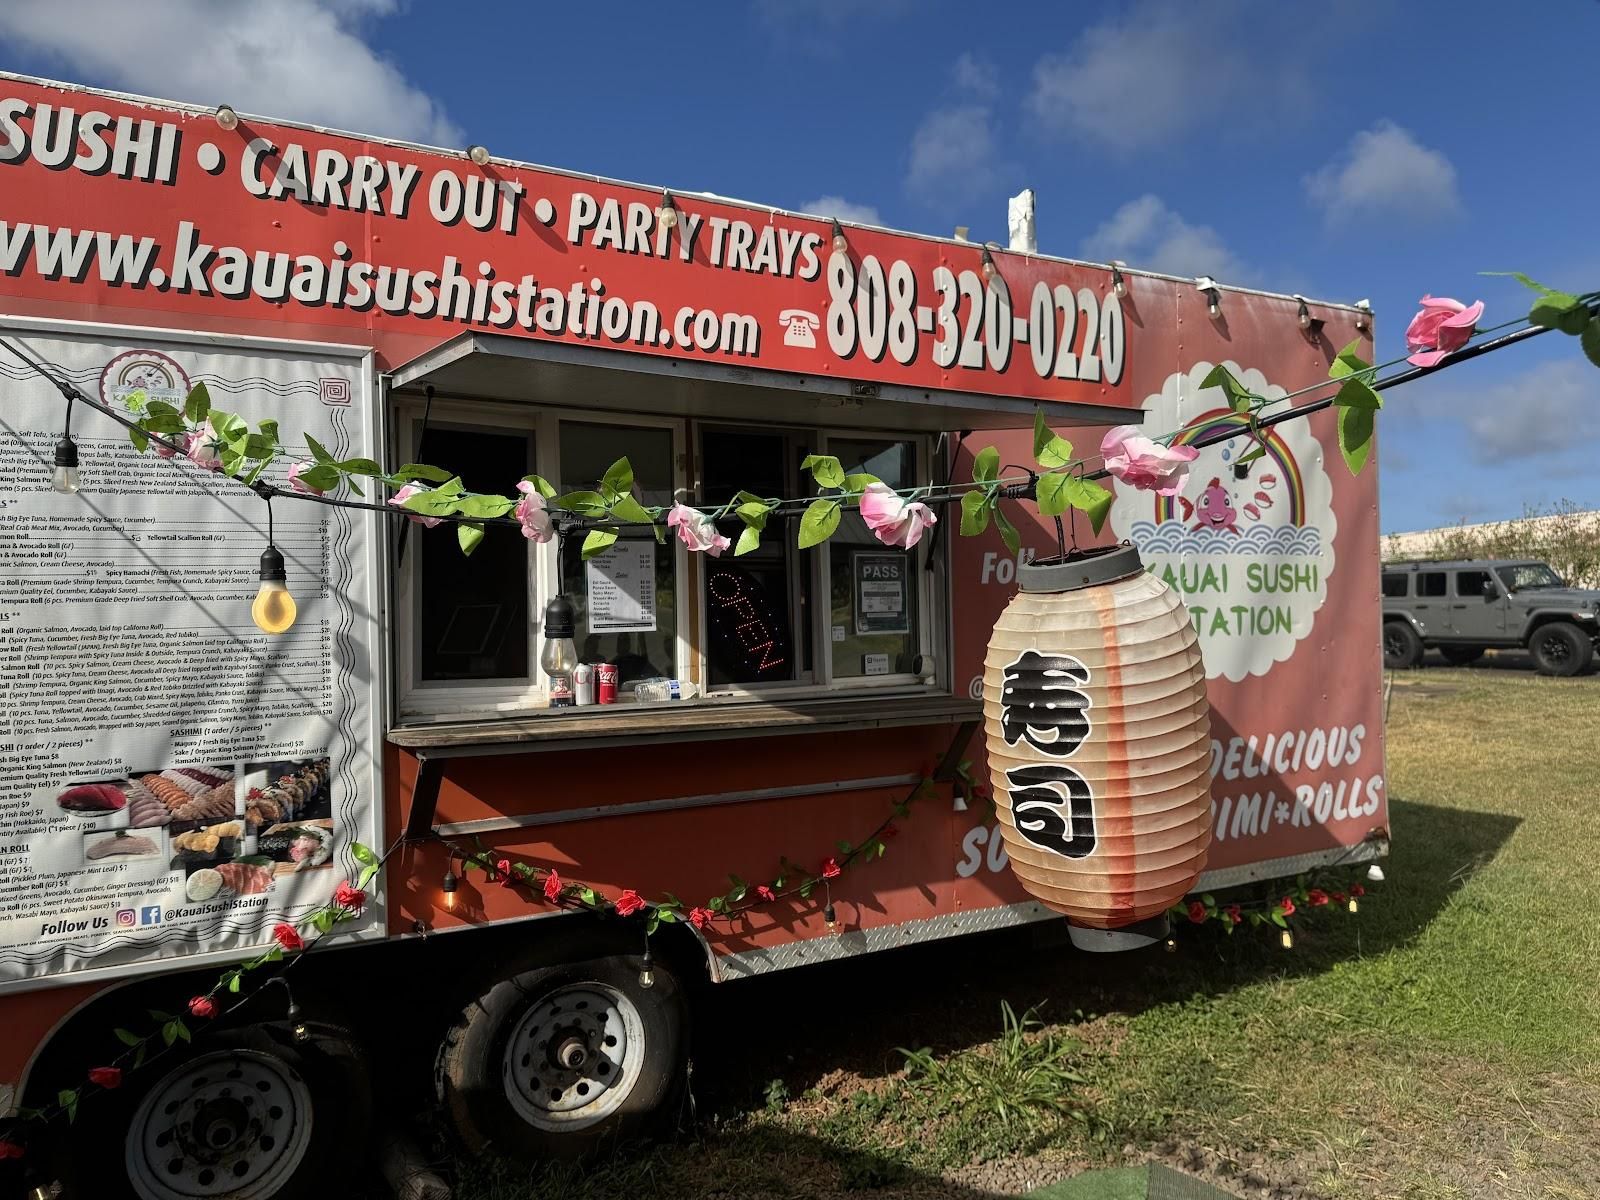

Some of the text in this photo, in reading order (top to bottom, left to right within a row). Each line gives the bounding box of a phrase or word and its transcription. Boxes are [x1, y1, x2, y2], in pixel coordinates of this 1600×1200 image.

[0, 98, 822, 280] SUSHI CARRY OUT PARTY TRAYS
[825, 251, 1125, 386] 808-320-0220
[98, 487, 119, 495] Quality
[863, 565, 899, 578] PASS
[1246, 563, 1319, 593] SUSHI
[1188, 605, 1293, 637] TATION
[59, 689, 81, 697] topped
[58, 738, 83, 749] pieces)
[195, 747, 218, 755] Organic
[270, 748, 298, 756] Yellowtail
[68, 760, 85, 768] (New
[25, 772, 48, 781] Quality
[68, 768, 100, 776] Yellowtail
[13, 782, 37, 791] Quality
[38, 780, 50, 789] Eel)
[48, 814, 69, 824] Japan)
[15, 824, 76, 835] Available) piece
[10, 844, 30, 853] ROLL
[11, 874, 37, 884] (Pickled
[57, 870, 84, 879] Japanese
[43, 889, 72, 898] Avocado,
[73, 886, 105, 894] Cucumber,
[127, 877, 156, 888] Dressing)
[21, 902, 28, 910] (6
[43, 899, 62, 907] Sweet
[64, 896, 84, 904] Potato
[85, 893, 116, 902] Okinawan
[15, 910, 39, 920] Wasabi
[60, 904, 88, 914] Kabayaki
[89, 901, 110, 910] Sauce)
[41, 920, 88, 936] Follow
[92, 917, 108, 928] Us
[164, 896, 268, 922] @KauaiSushiStation
